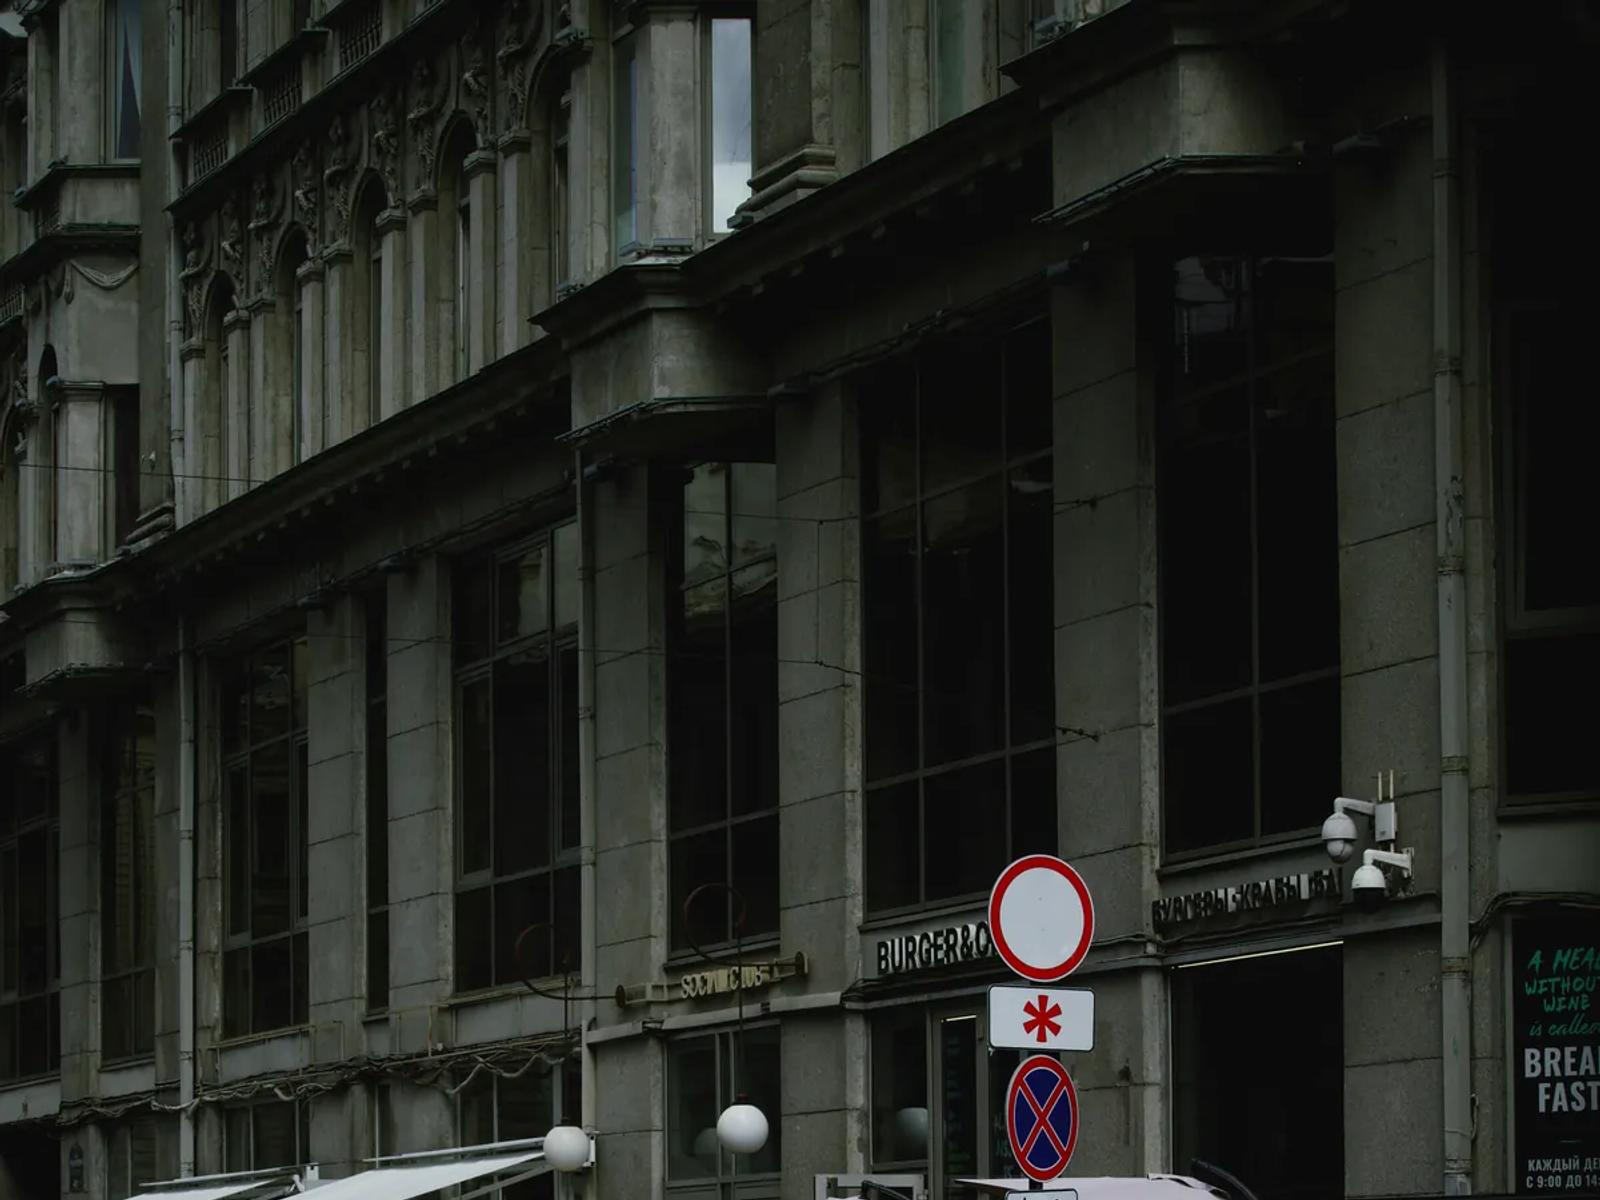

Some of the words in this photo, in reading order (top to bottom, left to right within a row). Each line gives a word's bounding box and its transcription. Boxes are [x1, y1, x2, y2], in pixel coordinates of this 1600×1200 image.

[1528, 949, 1543, 975] A
[1543, 994, 1591, 1013] WINE
[1529, 1020, 1542, 1036] is
[1524, 1046, 1600, 1078] BREA
[1538, 1081, 1600, 1113] FAST
[1527, 1155, 1580, 1173] КАЖДЫЙ
[1536, 1175, 1562, 1188] 9:00
[1565, 1174, 1582, 1189] ДО
